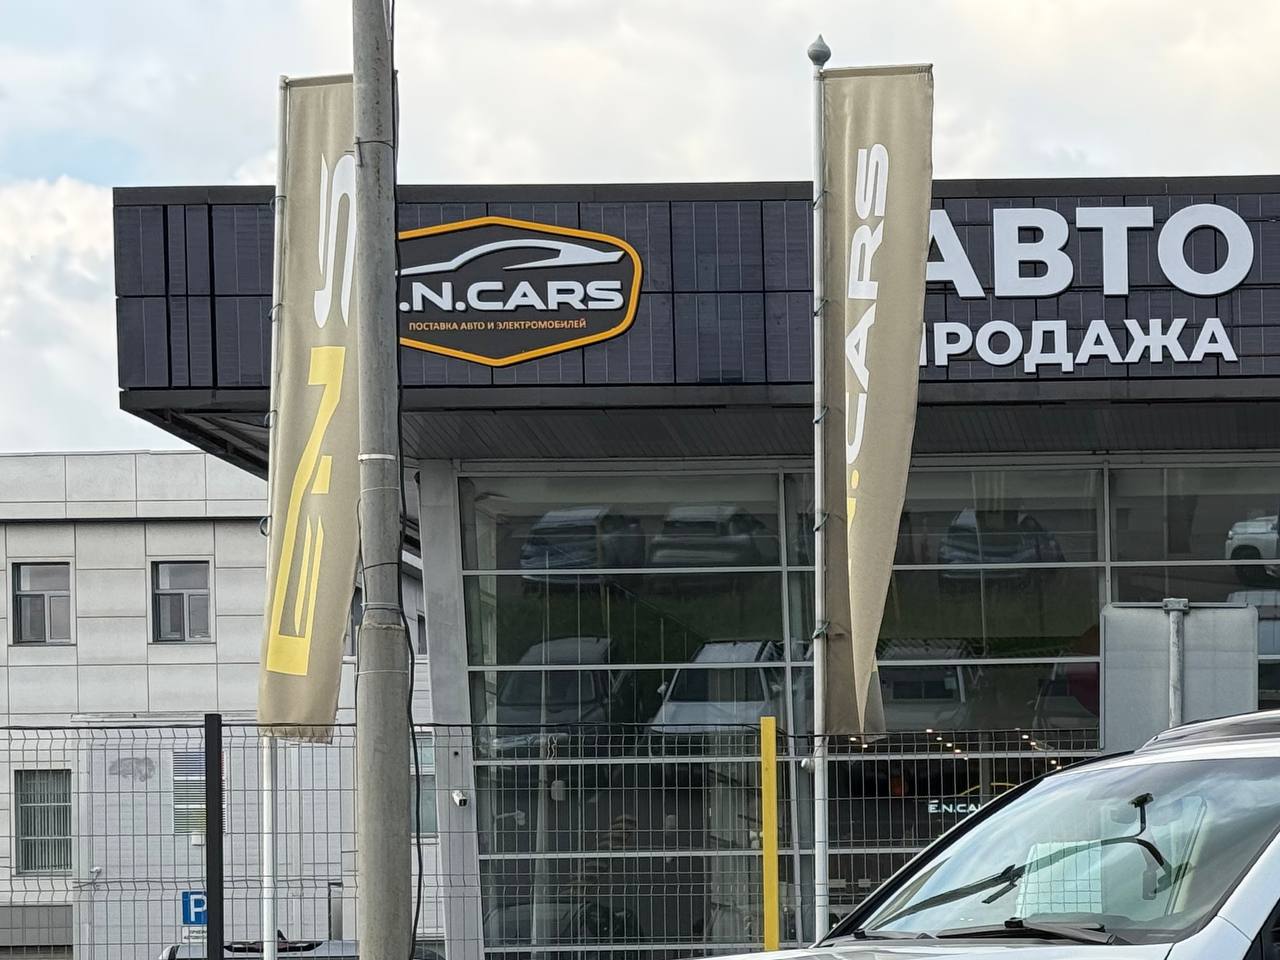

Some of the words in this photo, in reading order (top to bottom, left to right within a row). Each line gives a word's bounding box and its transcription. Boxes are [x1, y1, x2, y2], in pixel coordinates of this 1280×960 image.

[925, 203, 1255, 297] АВТО
[398, 280, 624, 312] .N.CARS
[408, 322, 458, 331] ПОСТАВКА
[460, 321, 485, 331] АВТО
[487, 321, 495, 330] И
[496, 318, 587, 330] ЭЛЕКТРОМОБИЛЕЙ
[844, 143, 891, 532] .CARS
[919, 316, 1238, 373] РОДАЖА
[928, 802, 982, 813] E.N.CA
[190, 894, 208, 922] P
